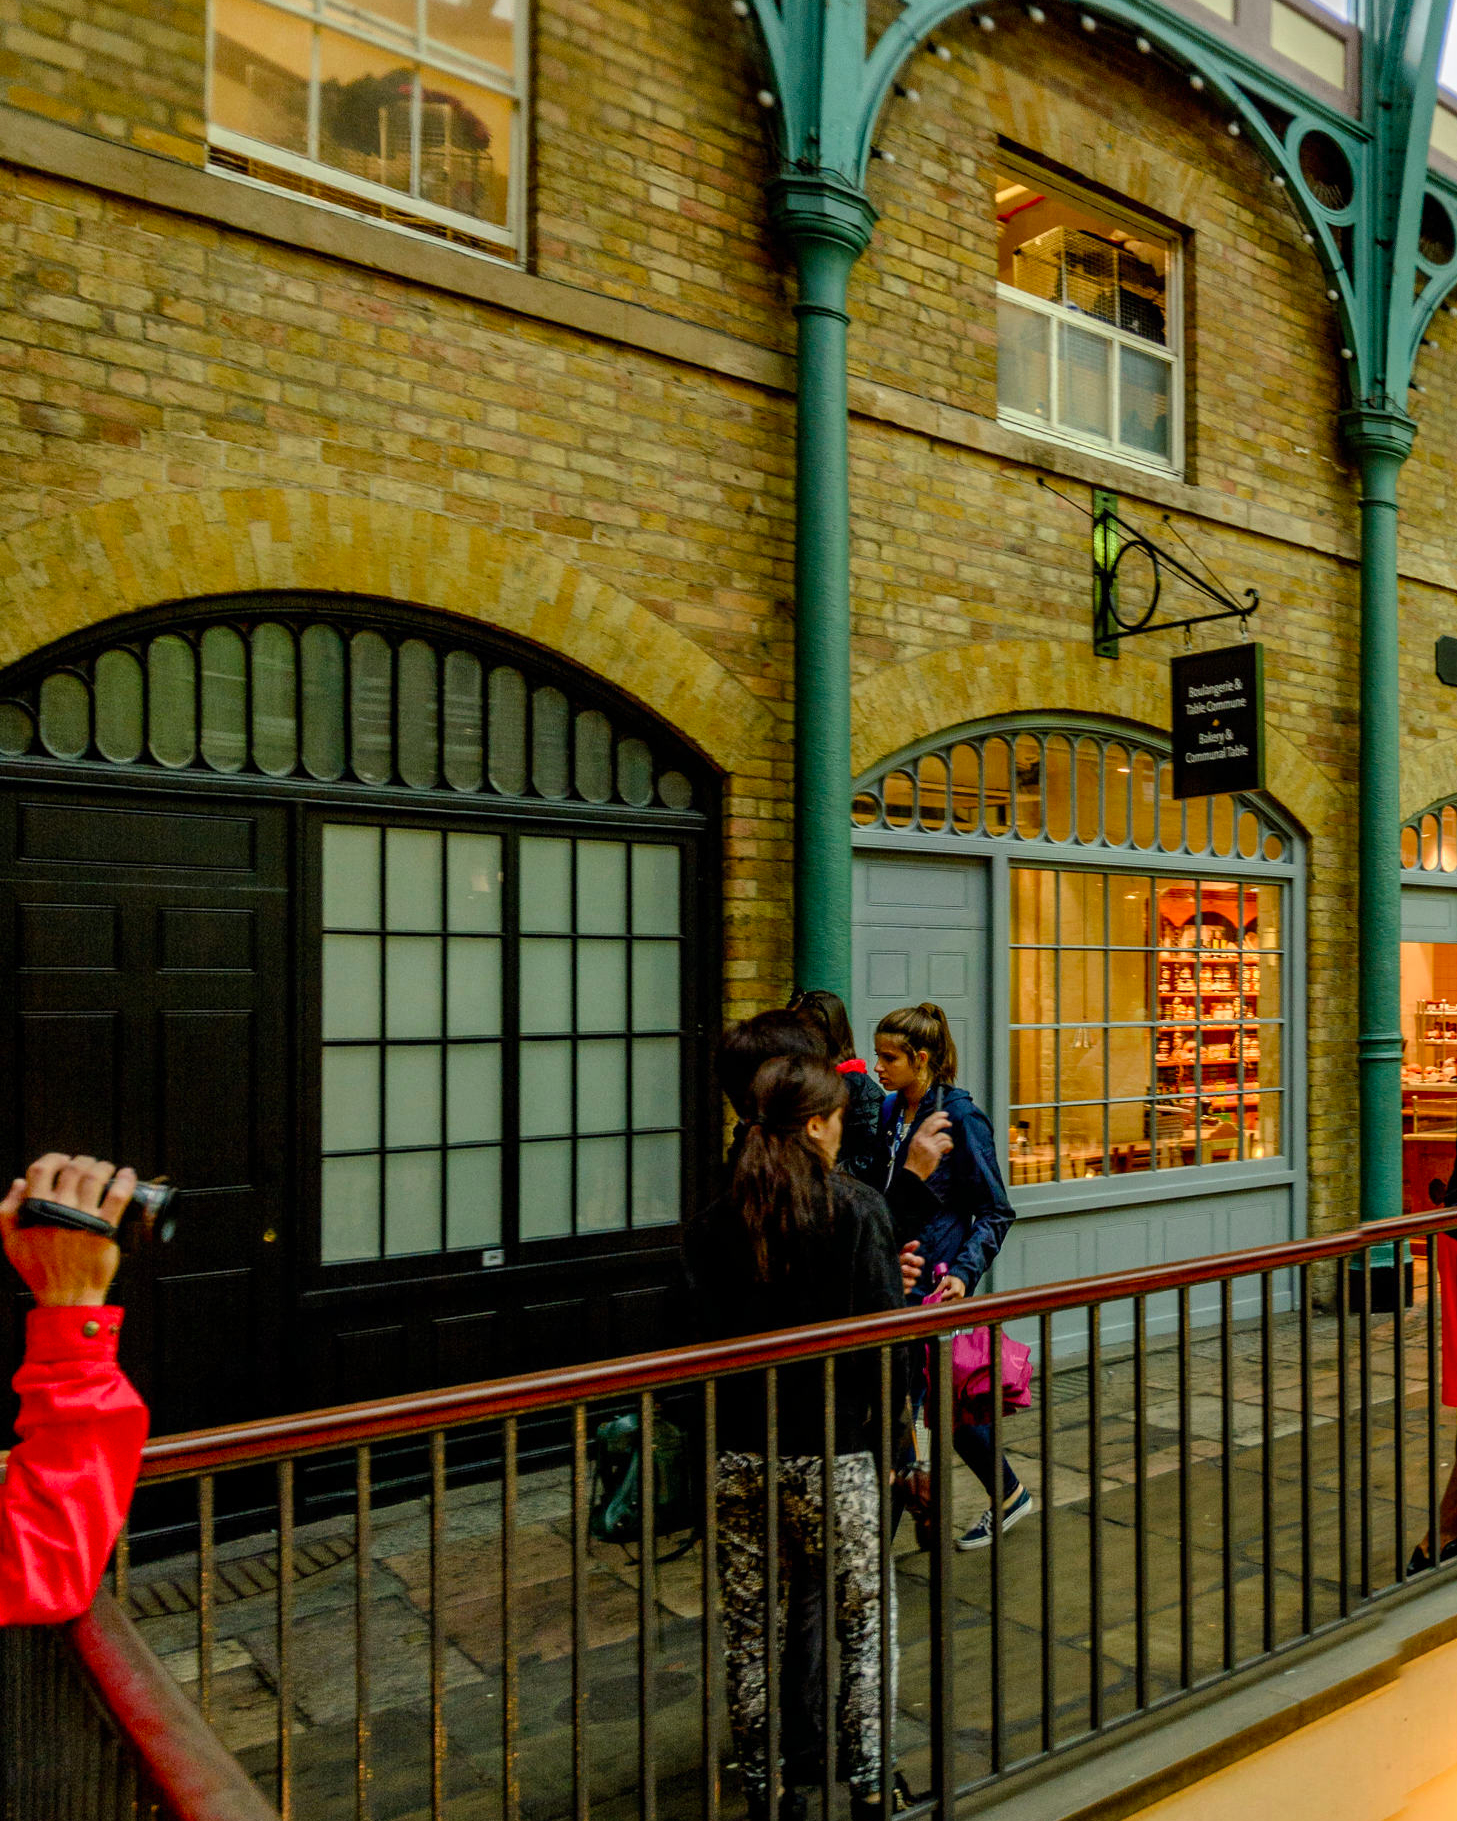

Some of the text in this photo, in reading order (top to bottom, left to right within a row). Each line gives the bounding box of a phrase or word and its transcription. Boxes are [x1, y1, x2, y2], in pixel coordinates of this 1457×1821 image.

[1188, 677, 1244, 698] Boulangerie &
[1184, 697, 1247, 716] Table Commune
[1198, 728, 1235, 745] Bakery &
[1185, 745, 1249, 764] Communal Table
